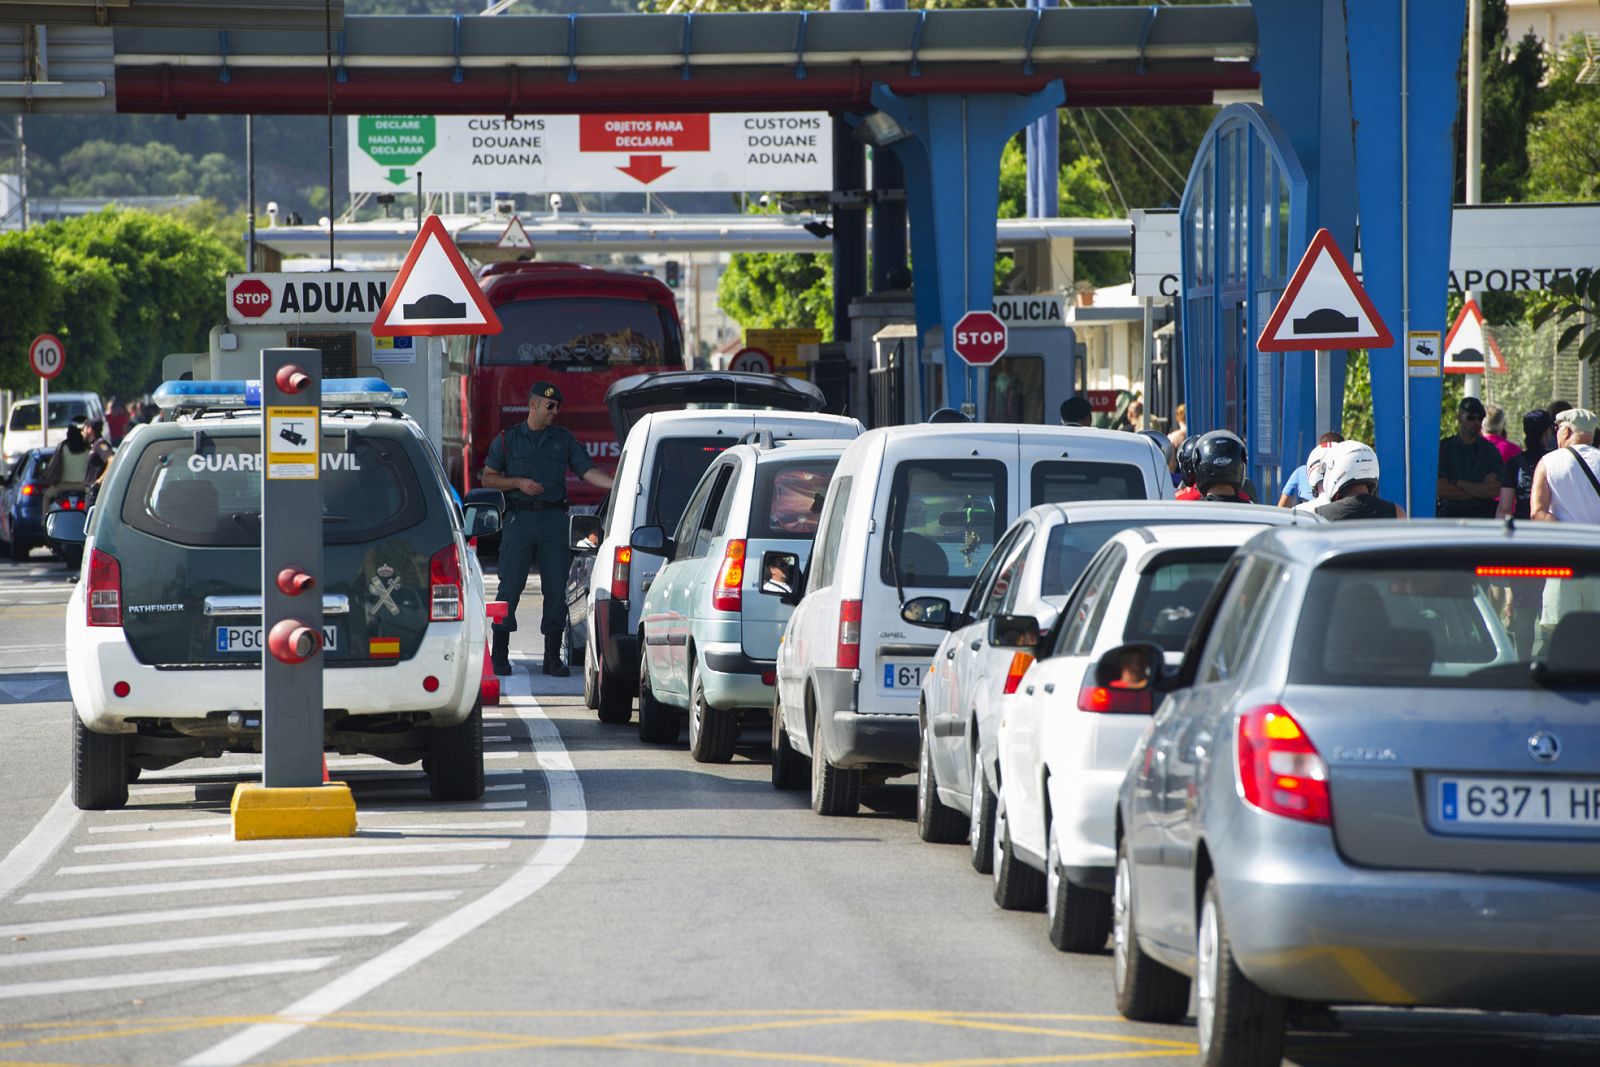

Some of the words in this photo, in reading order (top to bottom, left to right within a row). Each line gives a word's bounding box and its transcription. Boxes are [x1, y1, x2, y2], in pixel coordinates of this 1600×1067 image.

[375, 121, 420, 129] DECLARE
[468, 119, 545, 130] CUSTOMS
[605, 121, 652, 132] OBJETOS
[655, 121, 684, 131] PARA
[744, 118, 820, 129] CUSTOMS
[368, 135, 397, 144] NADA
[399, 135, 425, 144] PARA
[472, 137, 541, 148] DOUANE
[616, 136, 673, 146] DECLARAR
[748, 135, 817, 146] DOUANE
[371, 146, 423, 155] DECLARAR
[472, 154, 542, 165] ADUANA
[748, 153, 817, 164] ADUANA
[235, 293, 270, 305] STOP
[958, 332, 1004, 345] STOP
[38, 348, 57, 367] 10
[128, 603, 185, 614] PATHFINDER
[1466, 785, 1551, 818] 6371
